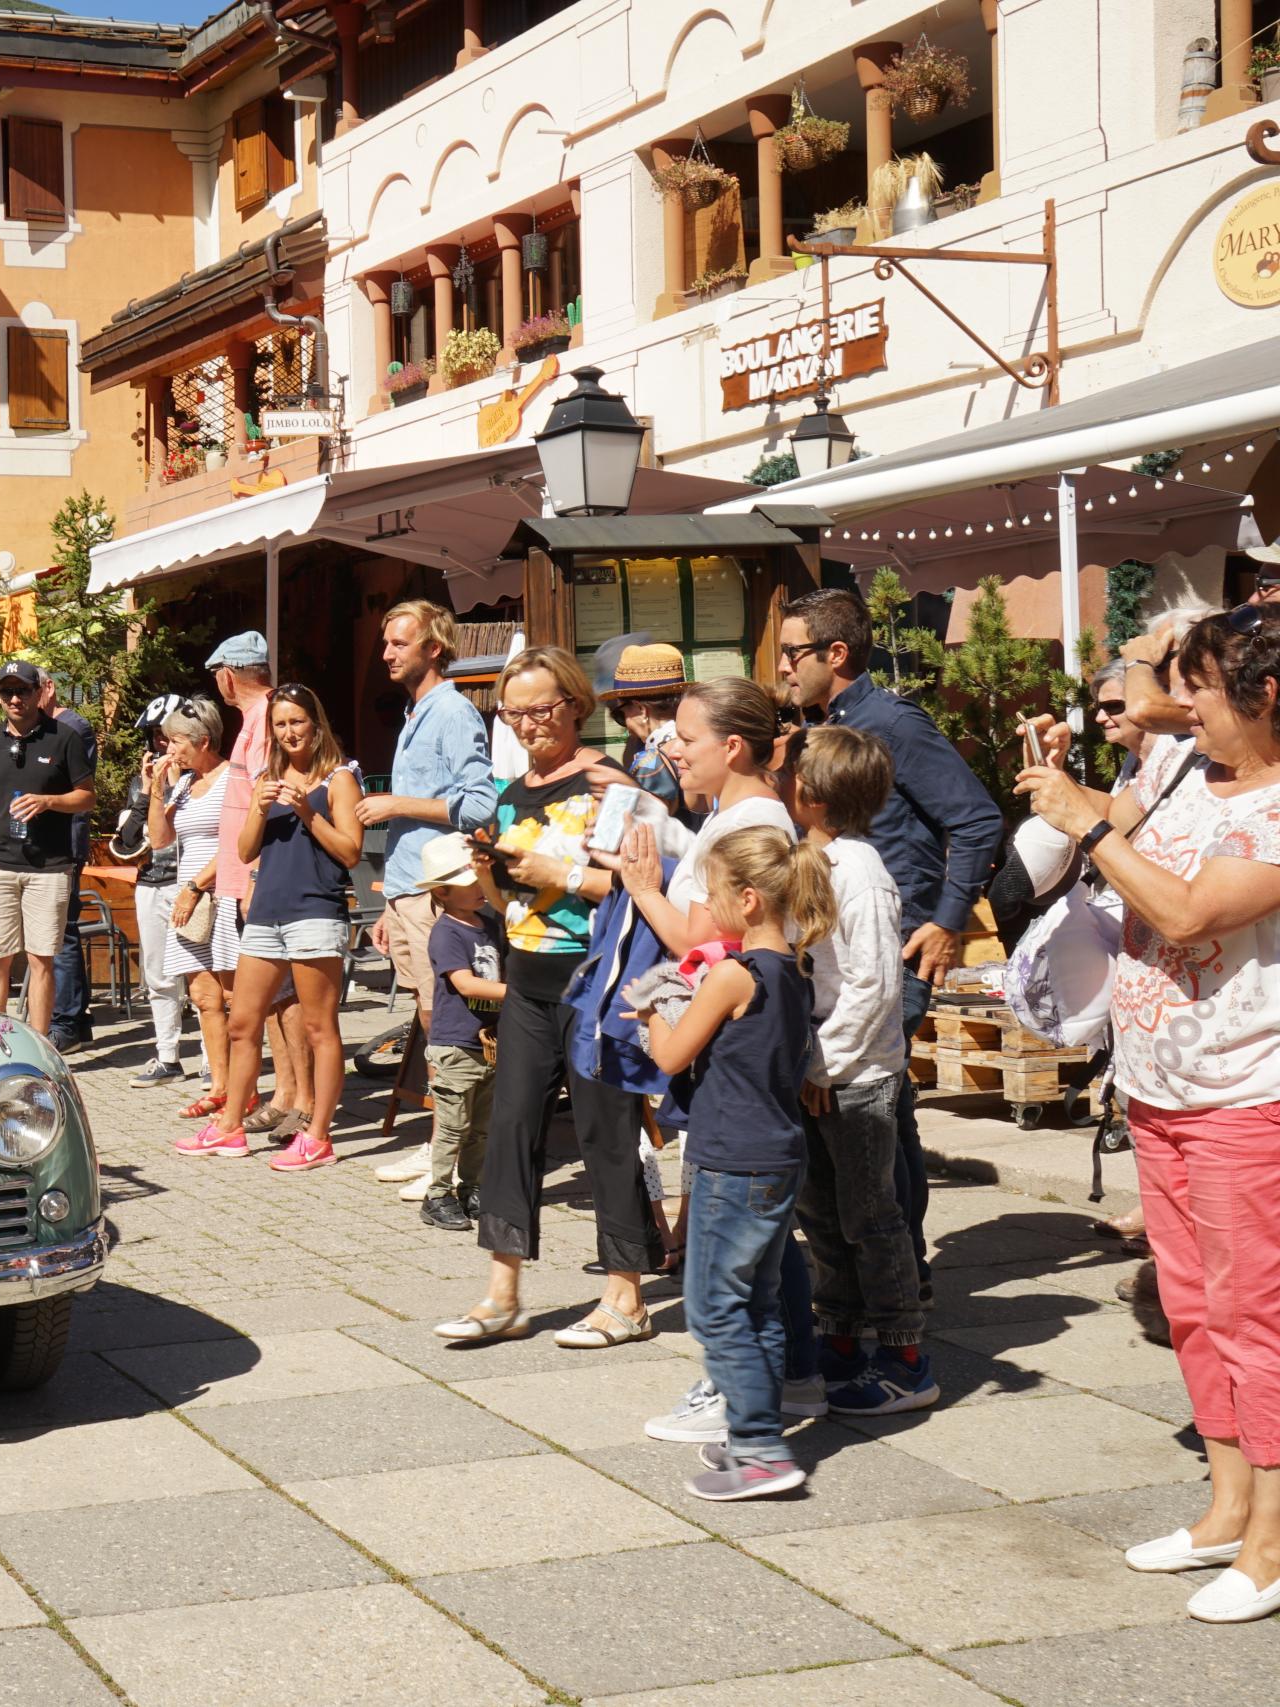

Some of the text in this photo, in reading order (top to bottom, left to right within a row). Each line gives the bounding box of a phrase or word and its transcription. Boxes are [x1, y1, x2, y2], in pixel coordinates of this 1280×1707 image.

[721, 303, 880, 379] BOULANGERIE
[266, 418, 330, 430] JIMBO LOLO
